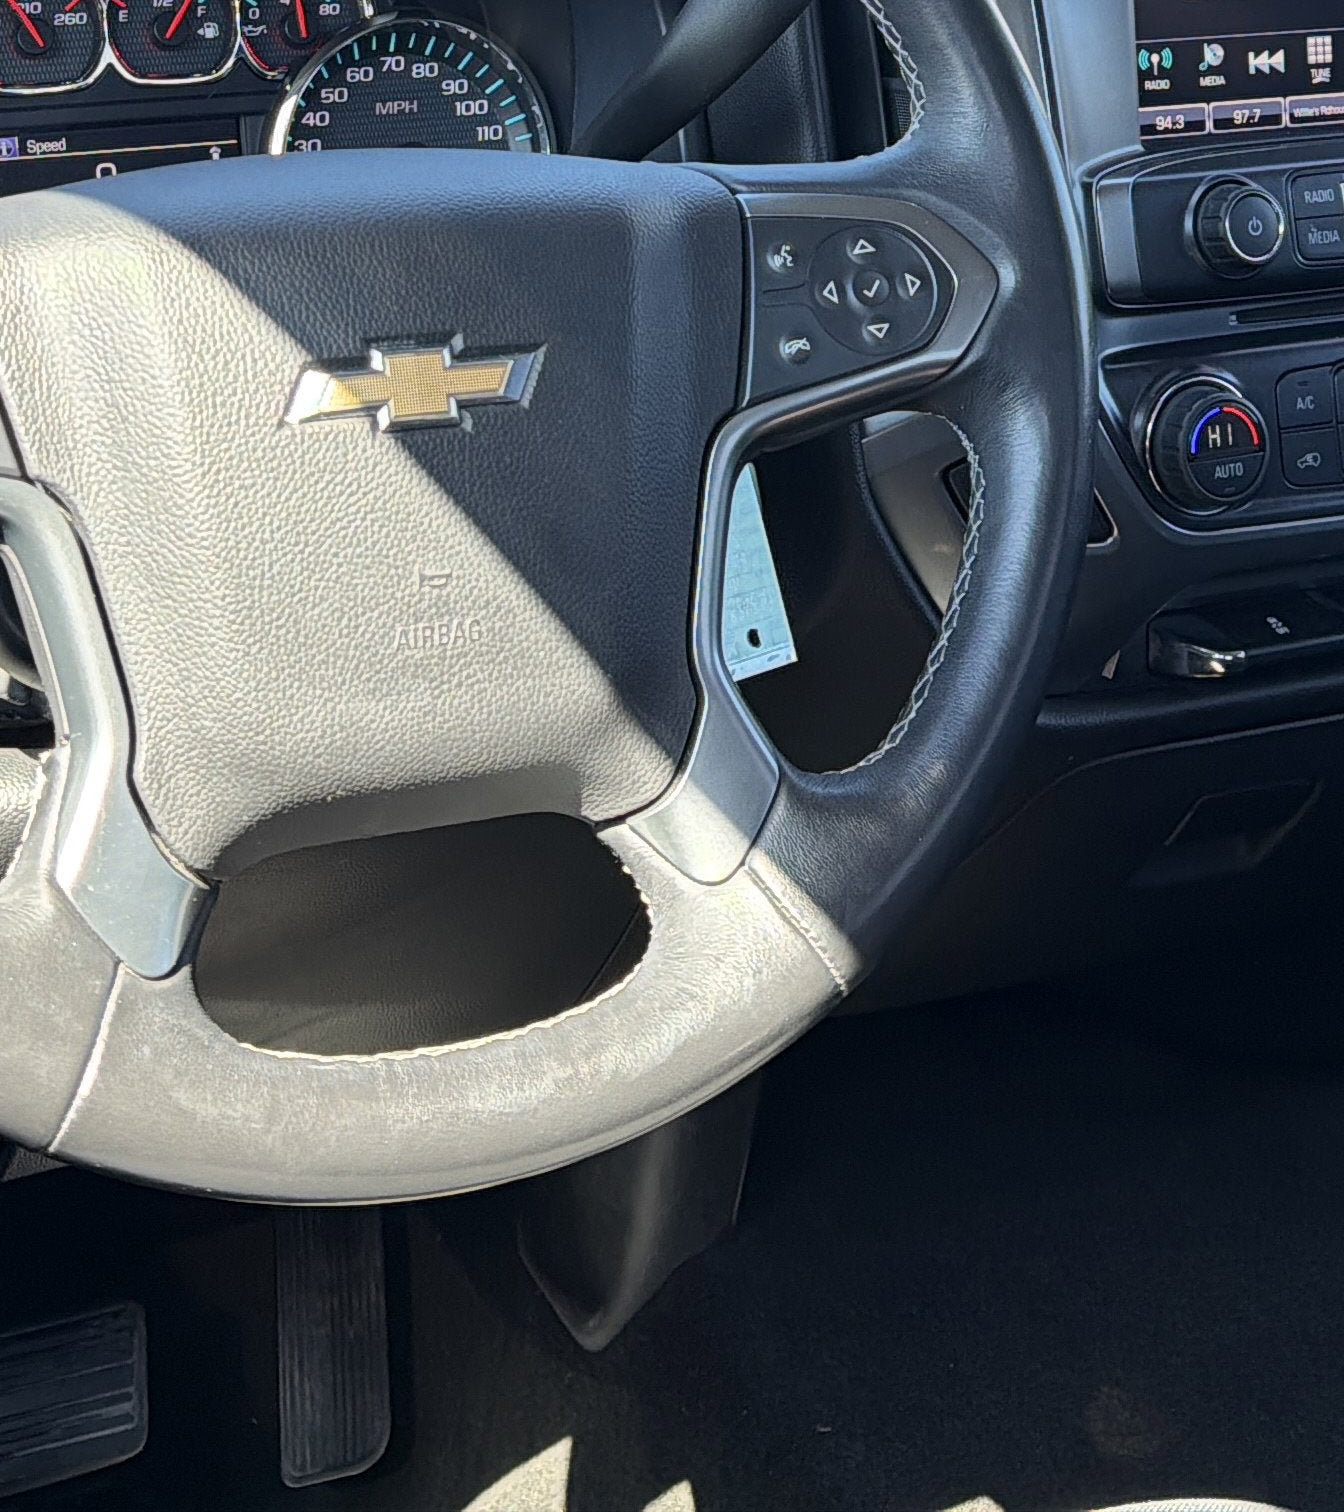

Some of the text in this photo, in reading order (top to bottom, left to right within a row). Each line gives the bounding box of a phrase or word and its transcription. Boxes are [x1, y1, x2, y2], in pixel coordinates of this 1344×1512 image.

[118, 10, 129, 23] E
[197, 5, 207, 18] F
[248, 7, 260, 20] 0
[319, 3, 341, 15] 80
[53, 13, 87, 26] 260
[380, 56, 405, 72] 70
[411, 62, 439, 78] 80
[346, 67, 374, 83] 60
[1199, 75, 1226, 87] MEDIA
[1310, 68, 1331, 78] TUNE
[441, 79, 469, 95] 90
[1144, 79, 1171, 91] RADIO
[320, 88, 349, 104] 50
[376, 100, 418, 115] MPH
[456, 100, 489, 116] 100
[301, 111, 330, 127] 40
[1155, 115, 1185, 131] 94.3
[1232, 109, 1261, 125] 97.7
[476, 125, 503, 141] 110
[26, 137, 66, 155] Speed
[1304, 189, 1335, 204] RADIO
[1308, 230, 1341, 245] MEDIA
[1296, 396, 1315, 410] A/C
[1208, 423, 1233, 448] HI
[1215, 462, 1244, 479] AUTO
[395, 618, 482, 651] AIRBAG
